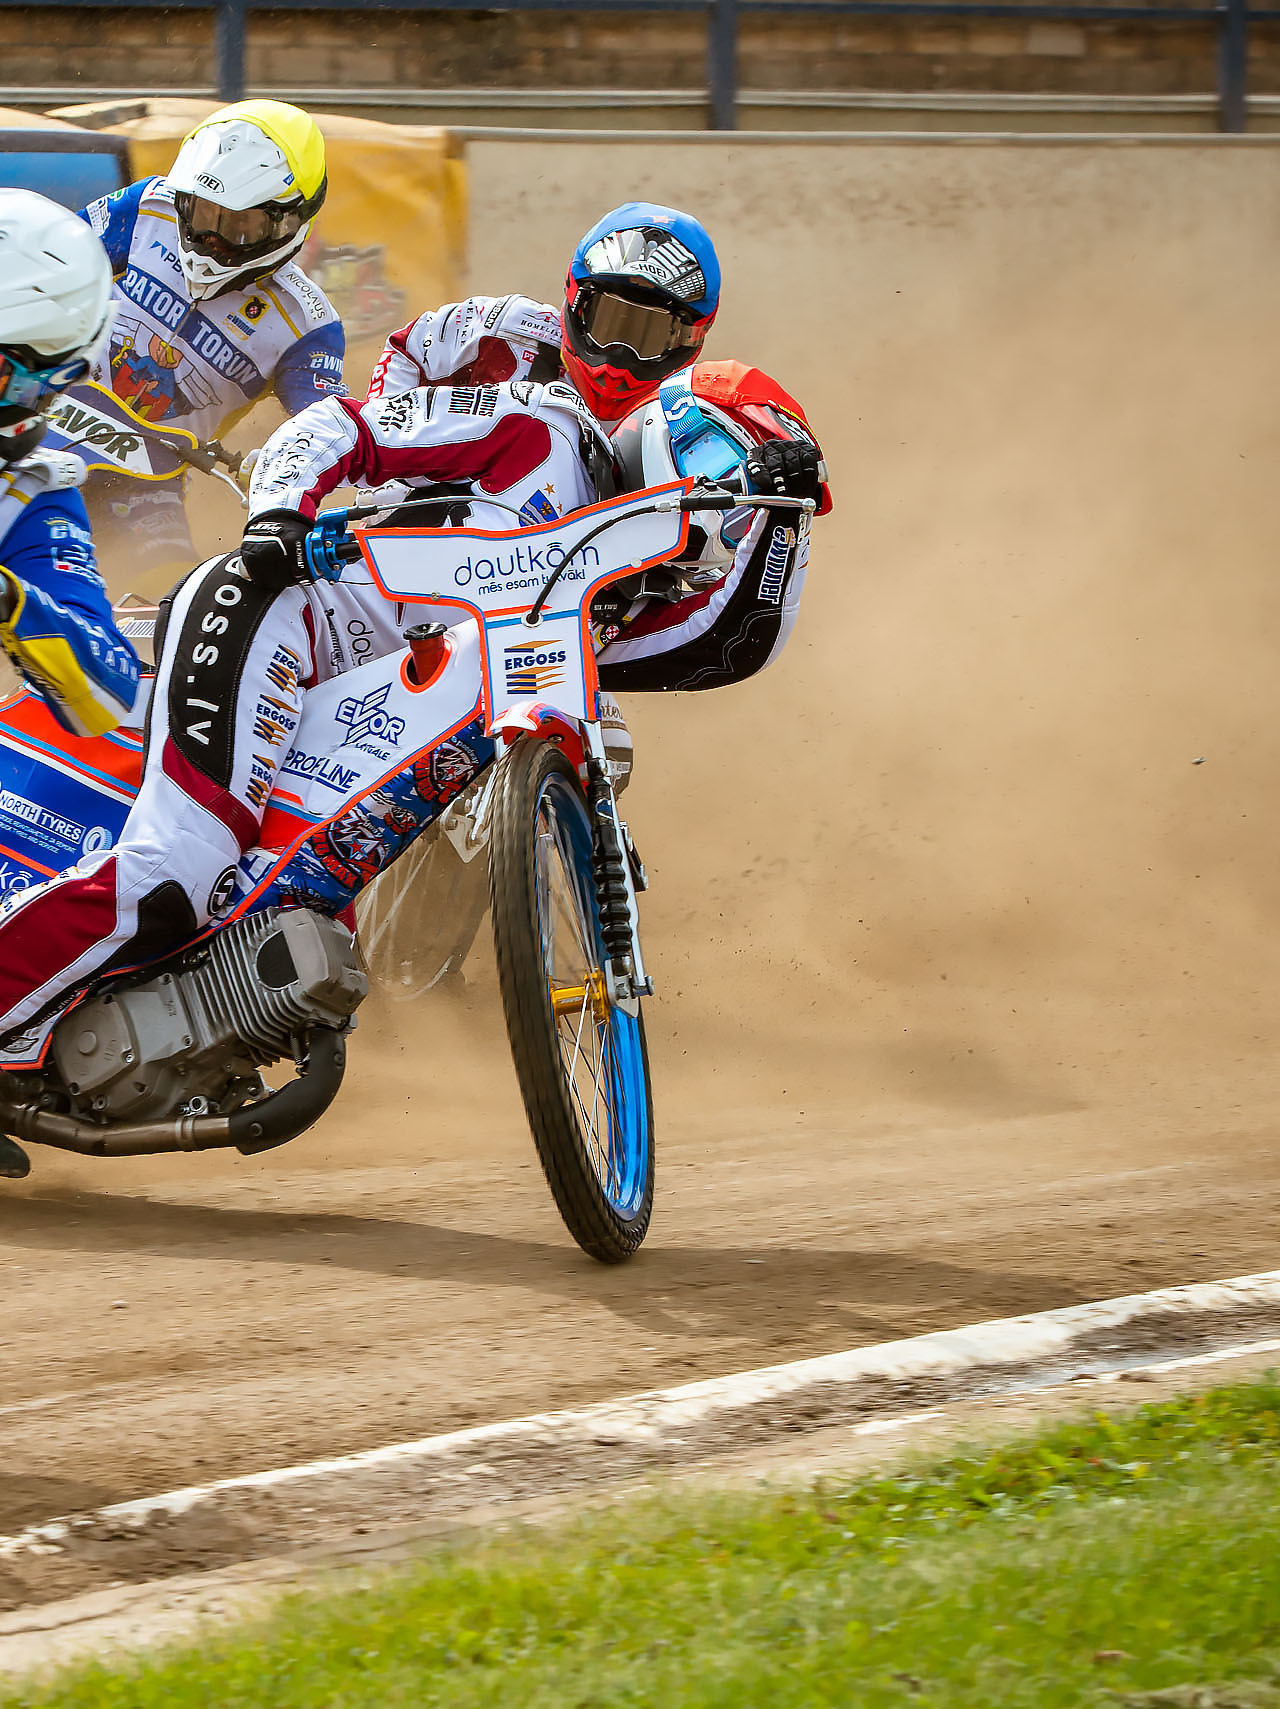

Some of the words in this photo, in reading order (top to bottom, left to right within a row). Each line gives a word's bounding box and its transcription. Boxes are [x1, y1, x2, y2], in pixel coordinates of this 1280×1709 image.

[629, 263, 668, 279] SHOEI
[286, 273, 326, 320] NICOLAUS
[48, 403, 140, 463] AVOR
[478, 582, 503, 596] mēs
[506, 577, 540, 590] esam
[504, 650, 567, 671] ERGOSS
[335, 690, 406, 746] EVOR
[42, 813, 84, 843] TYRES
